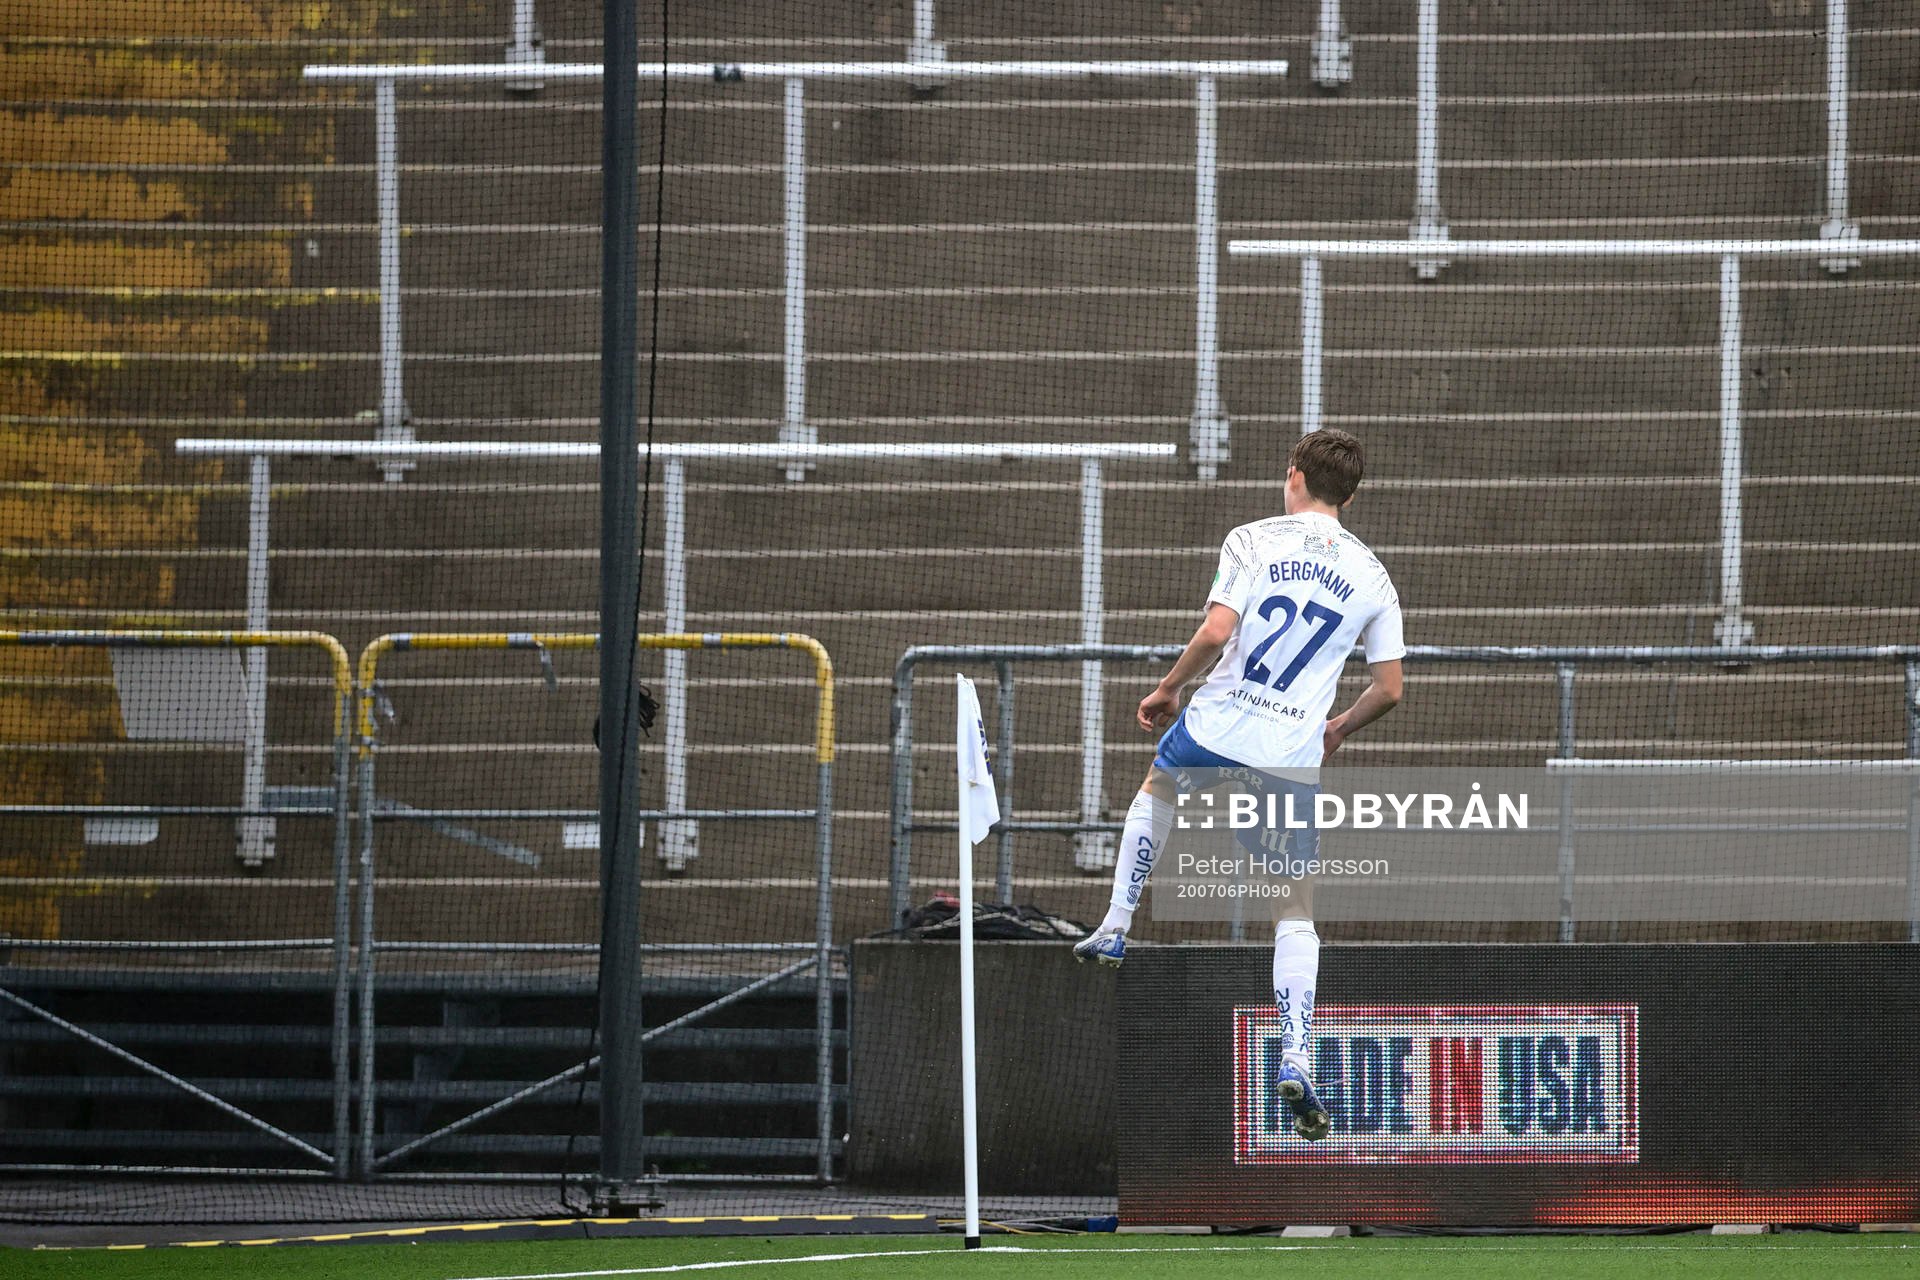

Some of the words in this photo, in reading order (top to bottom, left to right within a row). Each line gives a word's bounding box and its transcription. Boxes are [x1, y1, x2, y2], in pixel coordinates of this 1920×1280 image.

[1269, 561, 1354, 603] BERGMANN
[1242, 595, 1344, 693] 27
[1430, 1036, 1482, 1132] IN
[1503, 1036, 1601, 1133] USA
